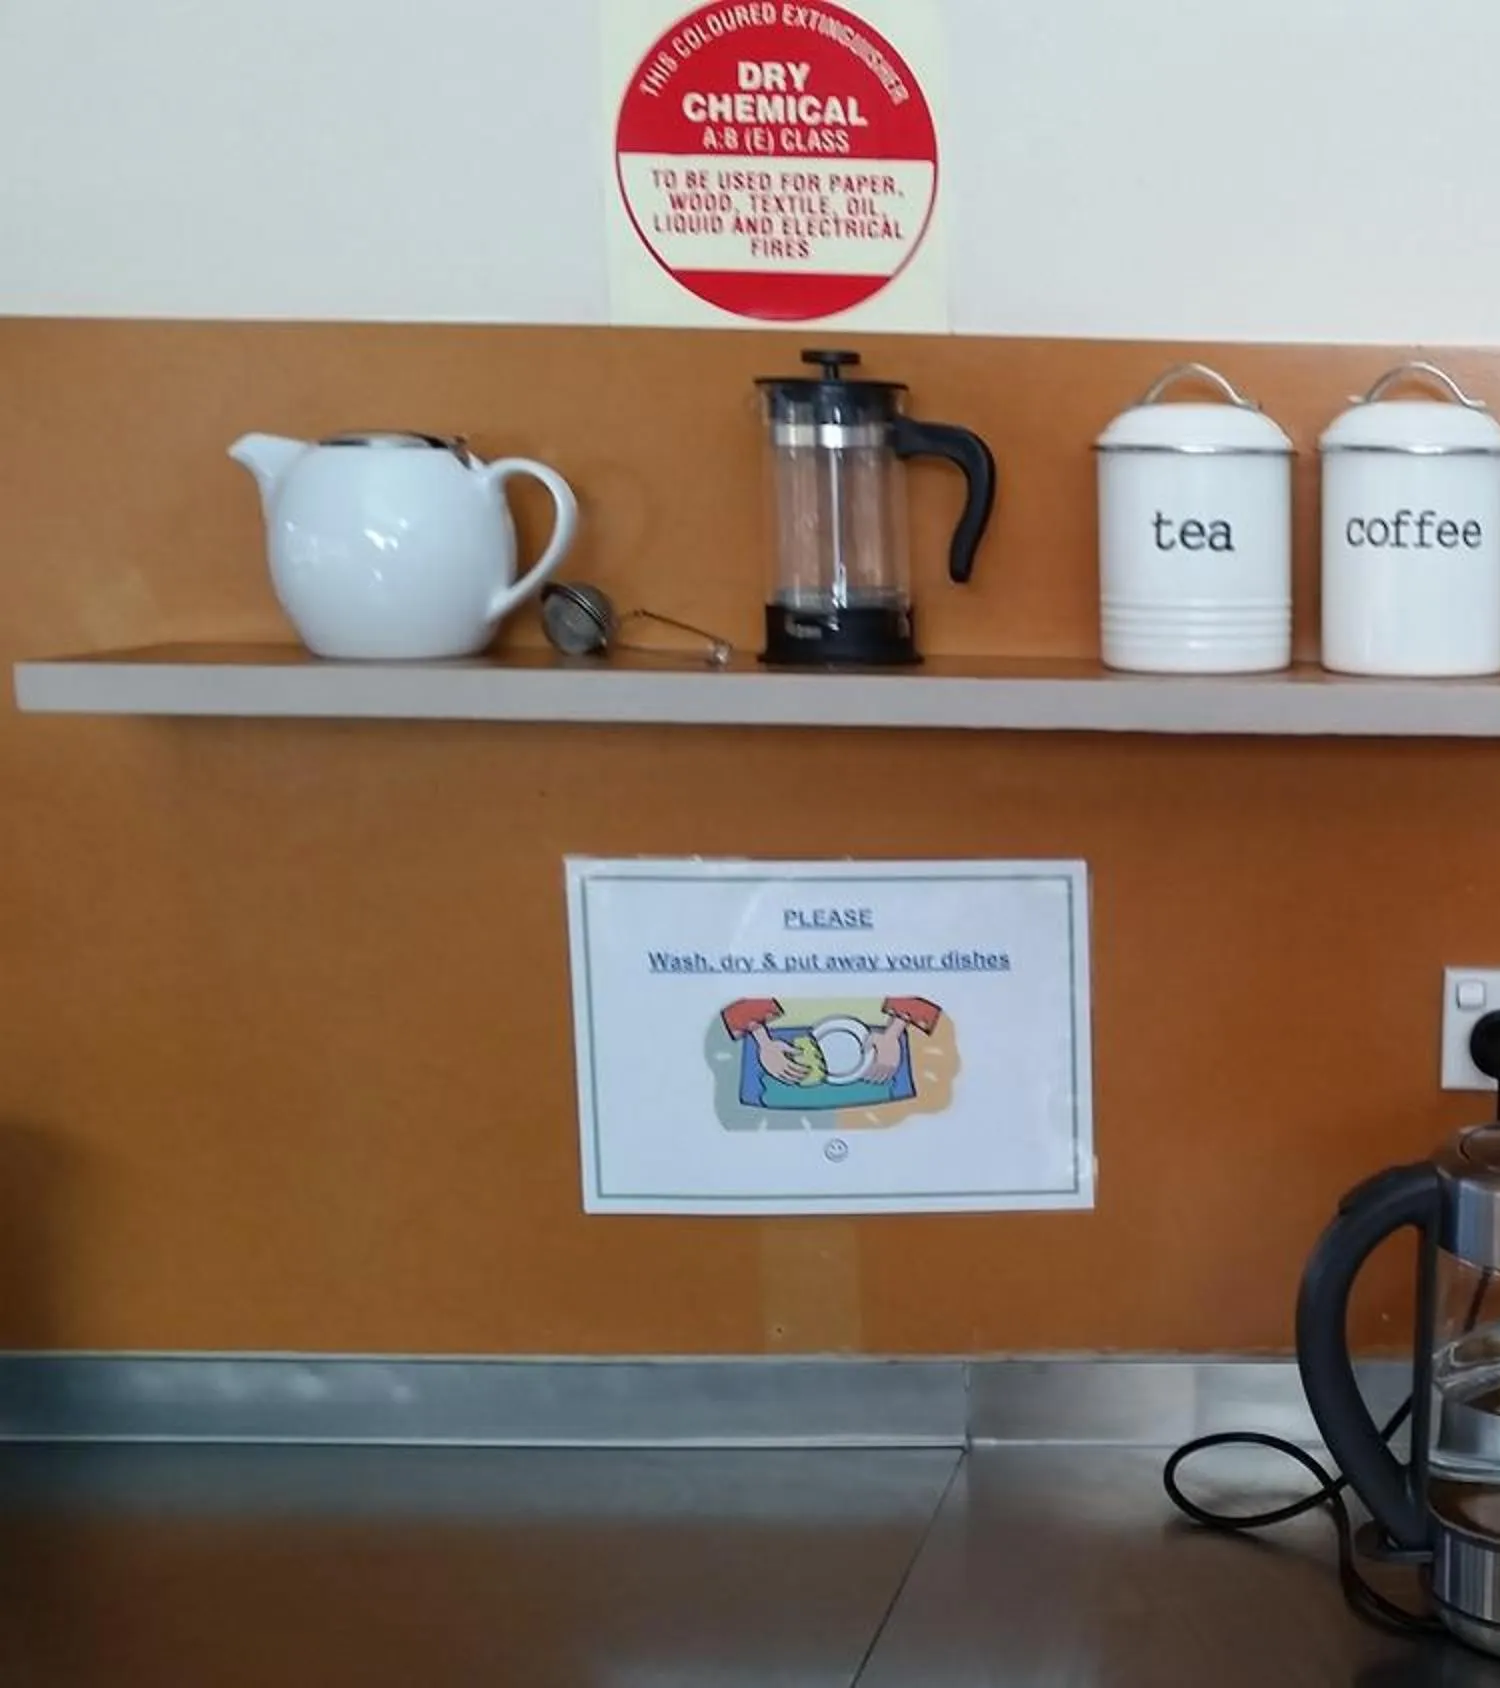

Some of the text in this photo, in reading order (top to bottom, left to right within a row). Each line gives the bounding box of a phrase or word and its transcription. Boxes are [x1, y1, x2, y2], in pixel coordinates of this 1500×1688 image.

[640, 51, 678, 97] THIS
[672, 2, 777, 58] COLOURED
[738, 61, 811, 92] DRY
[682, 92, 868, 127] CHEMICAL
[744, 127, 774, 154] (E)
[780, 128, 849, 154] CLASS
[652, 170, 905, 197] TO BE USED FOR PAPER,
[669, 193, 740, 215] WOOD,
[653, 214, 905, 240] LIQUID AND ELECTRICAL
[750, 239, 812, 259] FIRES
[1152, 510, 1235, 553] tea
[1345, 509, 1483, 550] coffee
[784, 908, 873, 930] PLEASE
[719, 952, 754, 974] dry
[761, 951, 778, 971] &
[784, 952, 822, 974] put
[826, 953, 879, 973] away
[884, 952, 936, 972] your
[940, 950, 1010, 972] dishes
